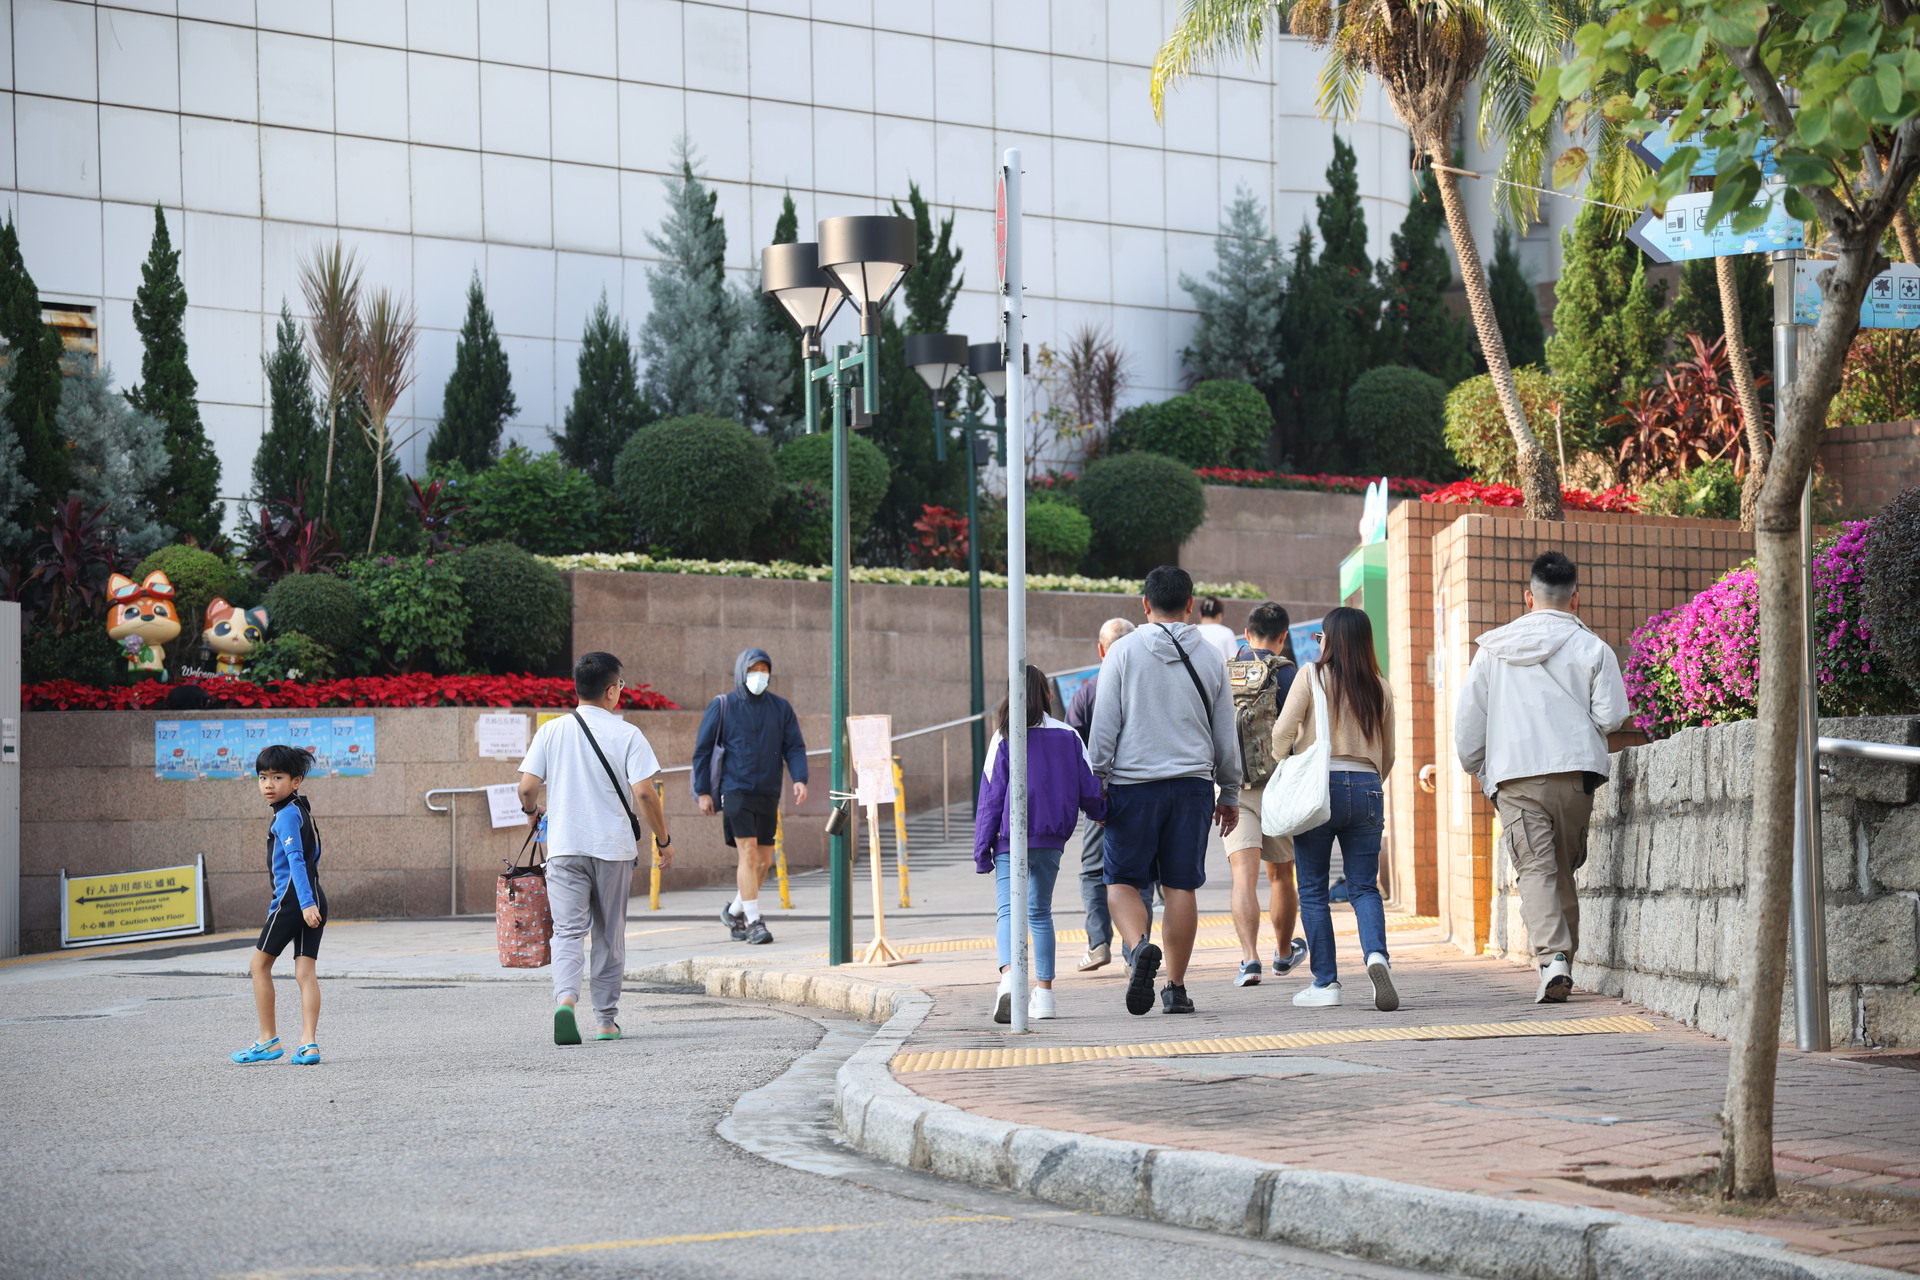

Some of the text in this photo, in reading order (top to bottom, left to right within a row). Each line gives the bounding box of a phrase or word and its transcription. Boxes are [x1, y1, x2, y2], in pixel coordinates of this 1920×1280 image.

[96, 900, 134, 909] Pedestrians
[135, 897, 157, 906] please
[103, 904, 163, 915] adjacent passages
[80, 921, 115, 930] 小心地滑
[120, 918, 149, 927] Caution
[166, 913, 185, 921] Floor
